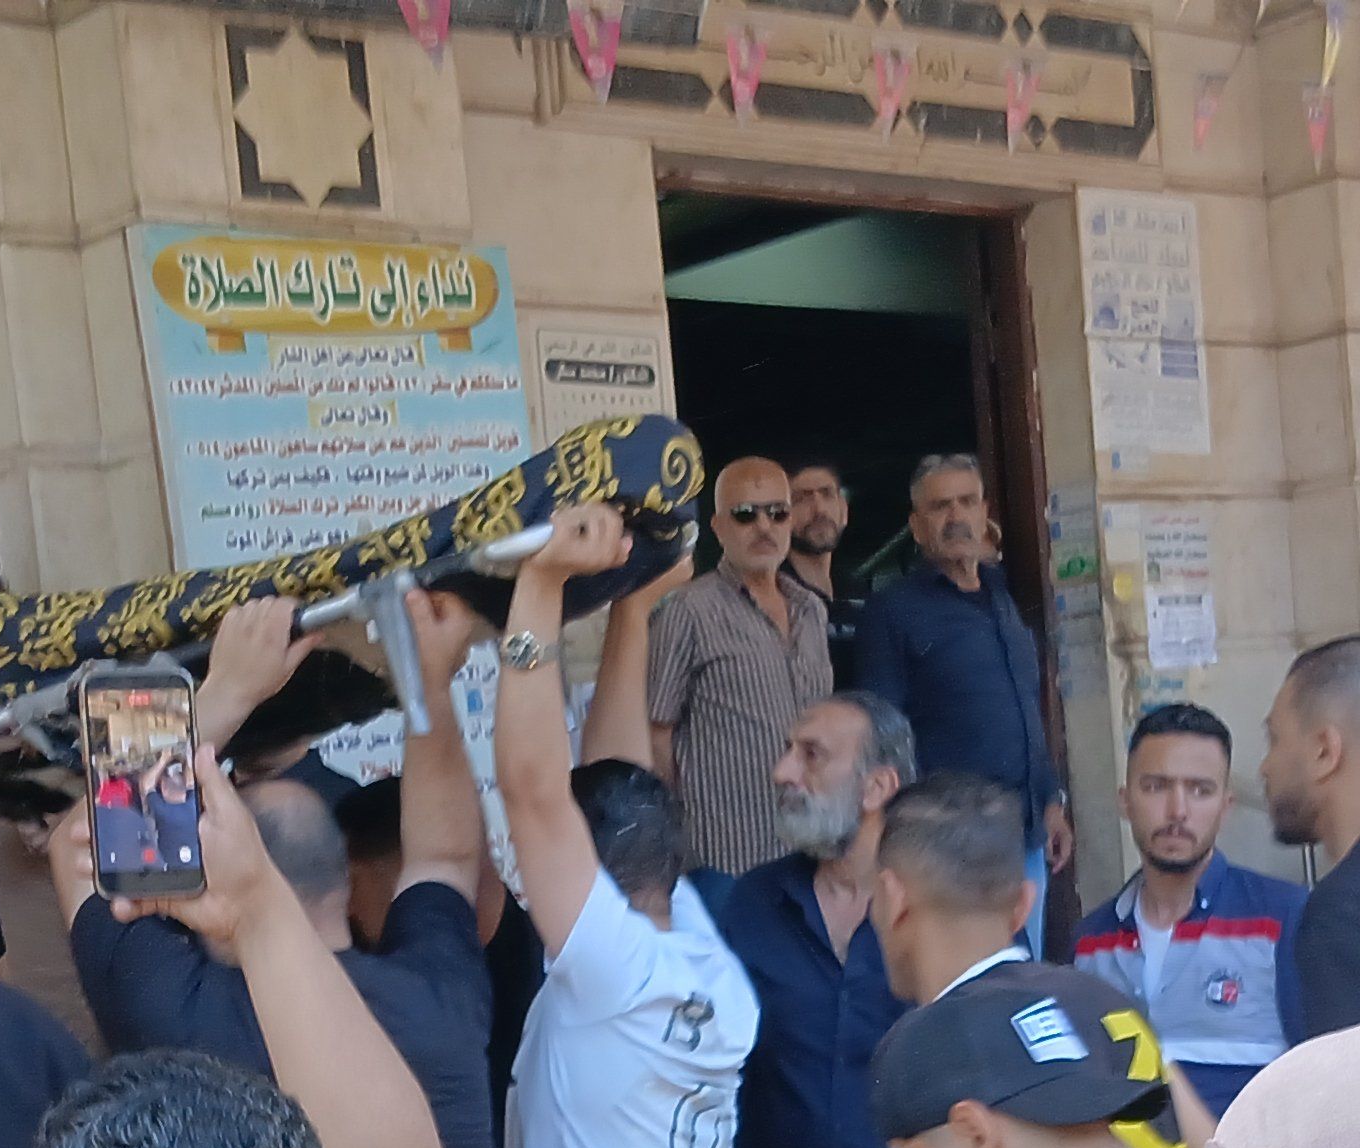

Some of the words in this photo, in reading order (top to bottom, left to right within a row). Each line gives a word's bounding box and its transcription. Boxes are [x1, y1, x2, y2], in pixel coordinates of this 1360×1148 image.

[178, 252, 282, 315] الصلاة
[284, 253, 365, 326] تارك
[368, 255, 414, 328] إلى
[415, 256, 476, 318] نداء
[390, 344, 415, 368] قال
[357, 404, 389, 427] وقال
